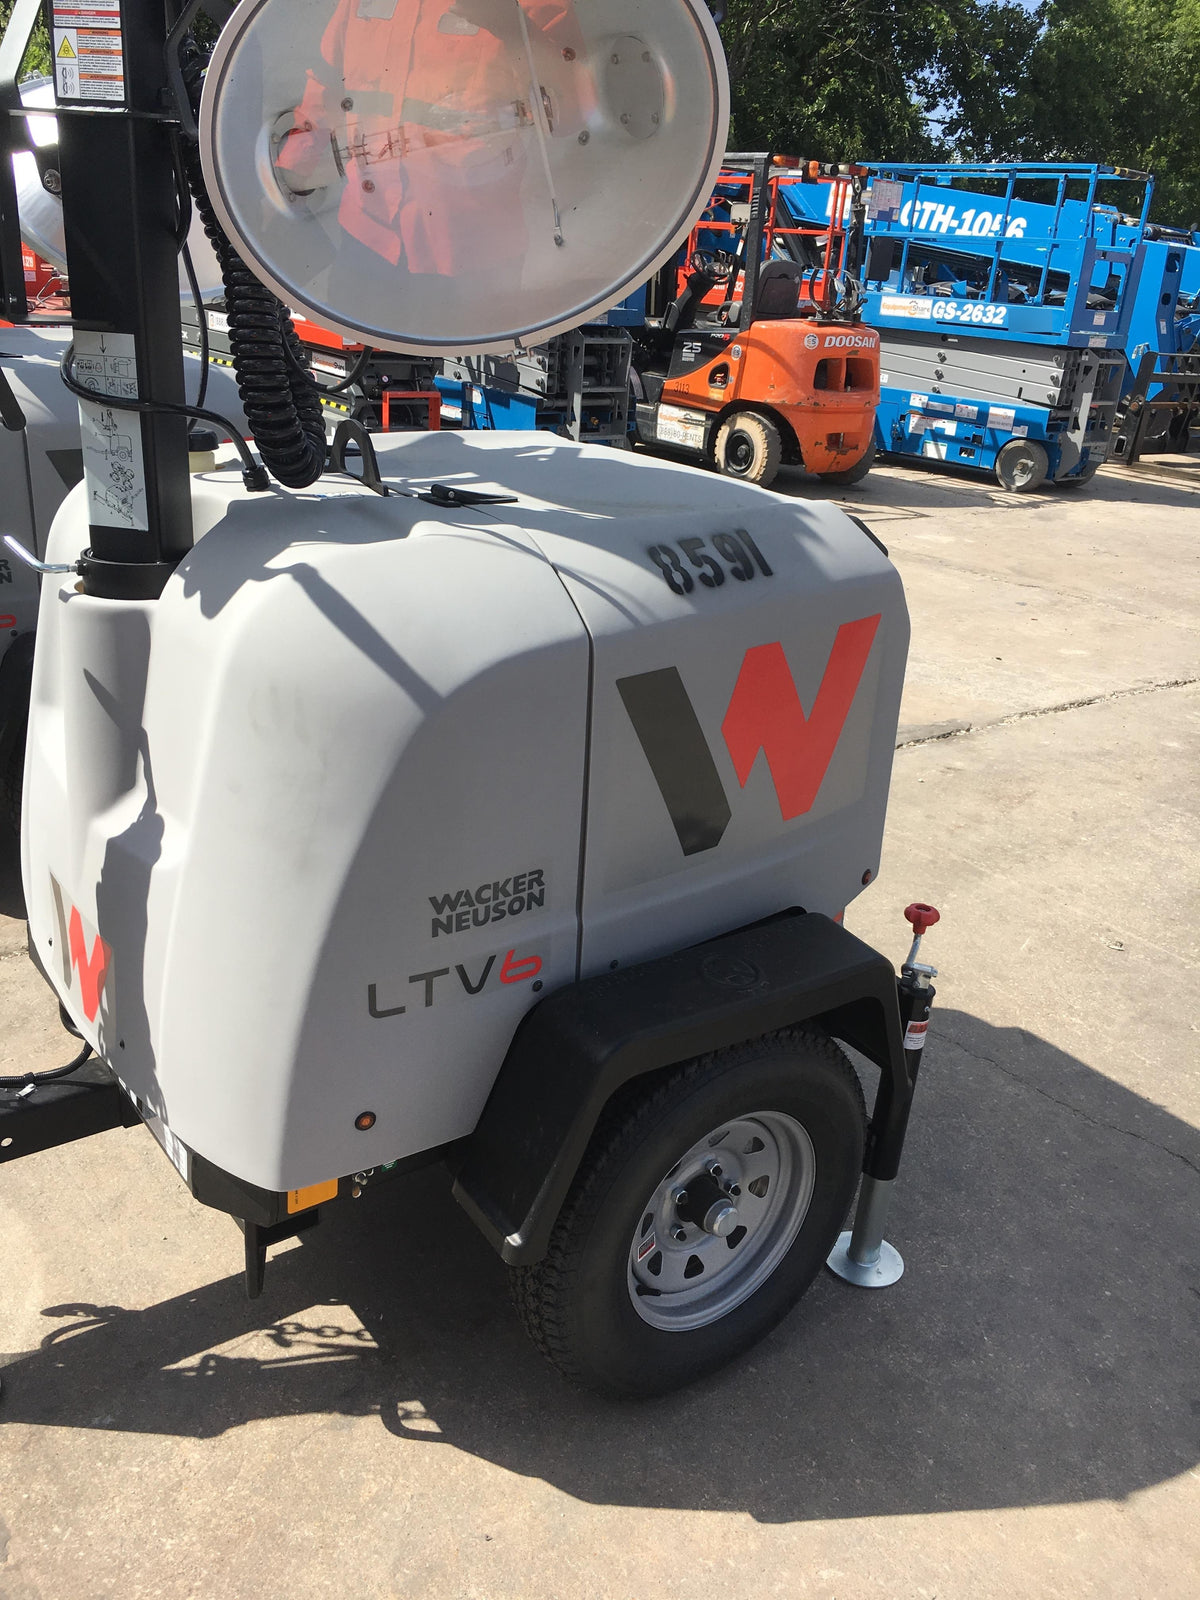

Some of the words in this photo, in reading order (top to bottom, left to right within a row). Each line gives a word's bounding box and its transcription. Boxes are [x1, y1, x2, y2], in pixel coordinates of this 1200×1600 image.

[932, 301, 1007, 325] GS-2632
[682, 341, 702, 353] 25
[824, 335, 876, 348] DOOSAN
[673, 382, 690, 395] 3113
[647, 528, 774, 595] 8591
[428, 868, 546, 915] WACKER
[431, 888, 545, 938] NEUSON
[367, 949, 543, 1019] LTV6
